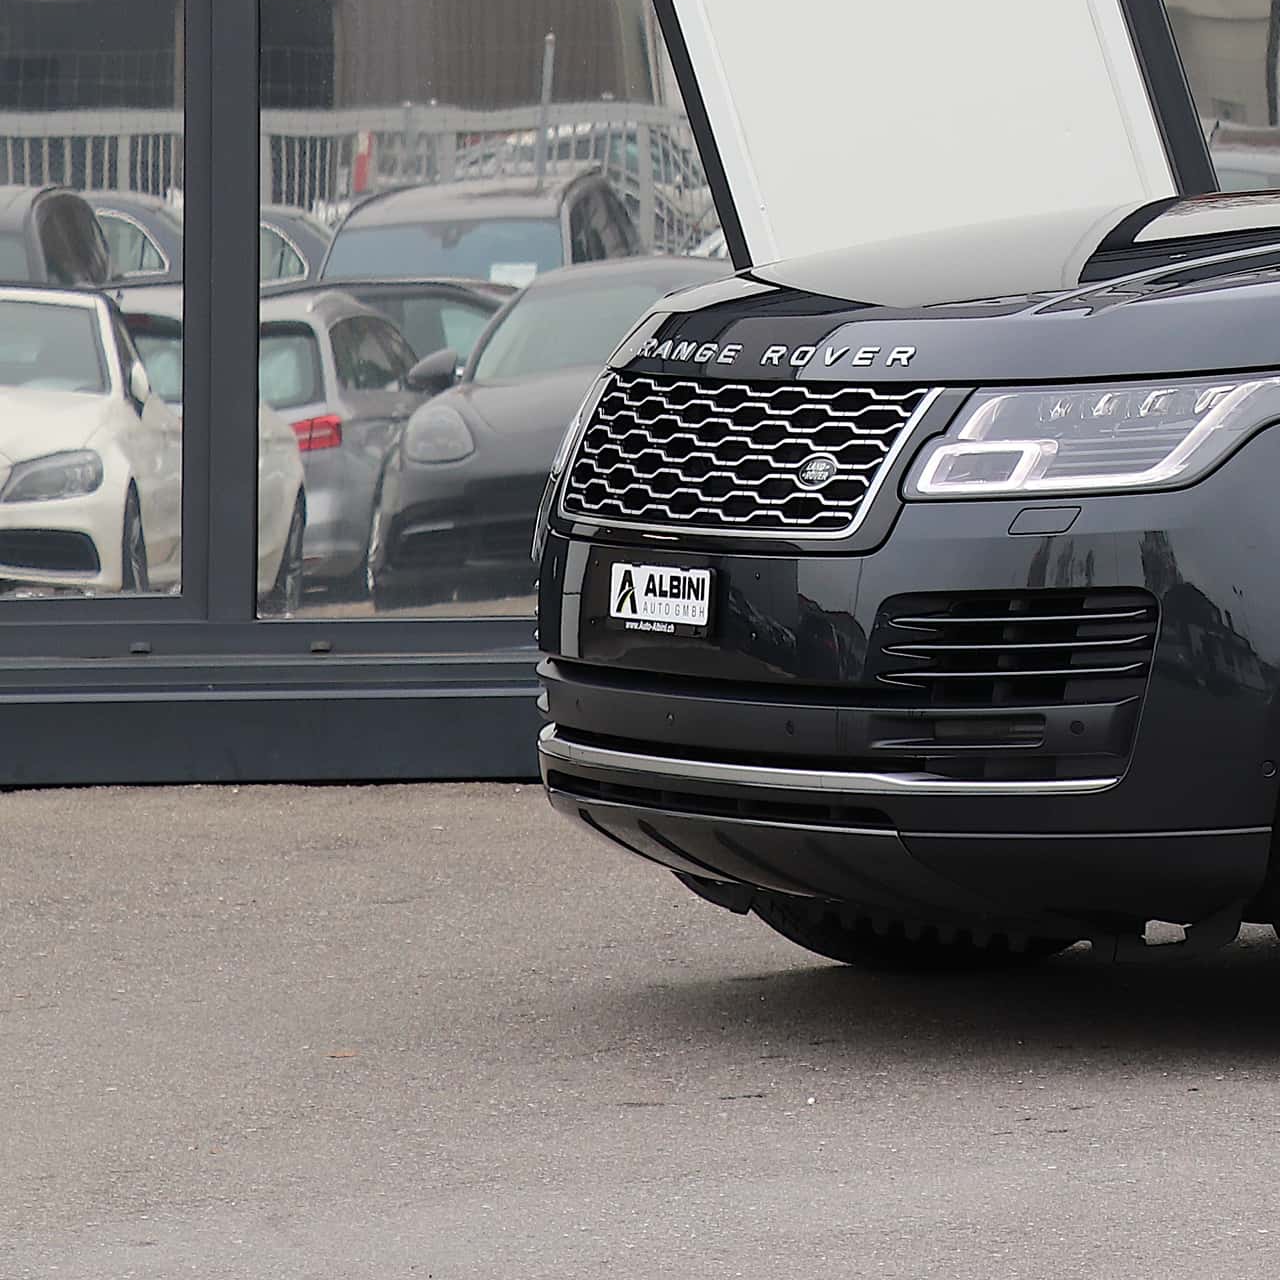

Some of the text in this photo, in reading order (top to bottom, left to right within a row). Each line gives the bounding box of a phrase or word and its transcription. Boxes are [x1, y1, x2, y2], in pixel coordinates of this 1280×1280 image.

[637, 338, 917, 368] RANGE ROVER
[644, 573, 706, 602] ALBINI
[643, 601, 705, 618] AUTO GMBH
